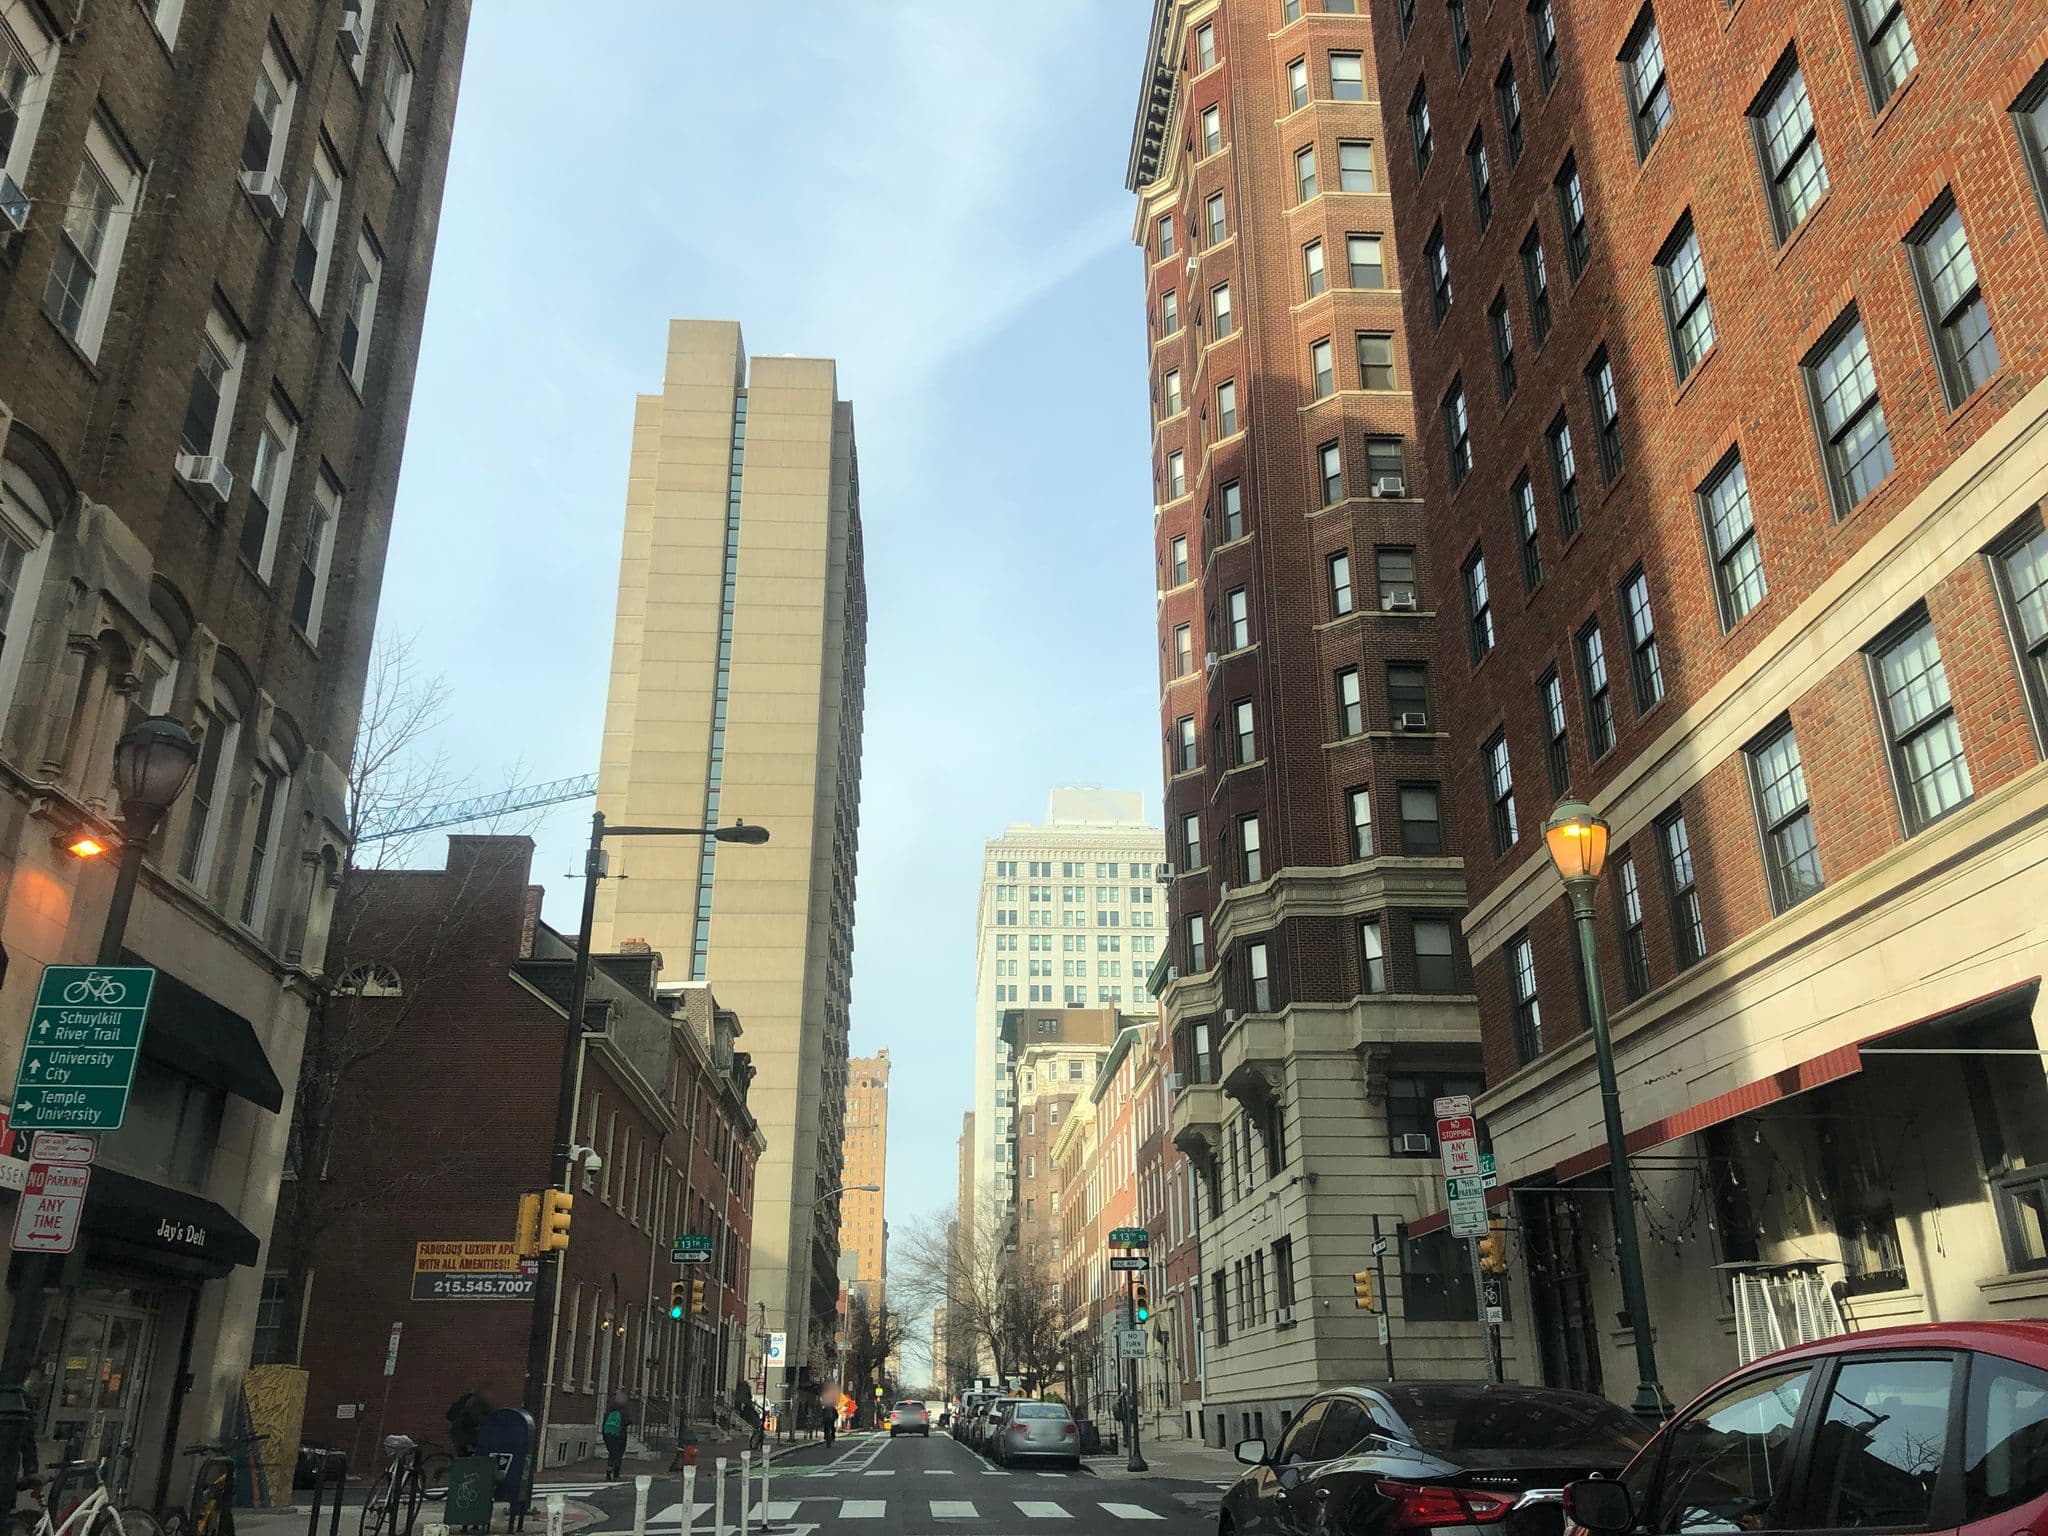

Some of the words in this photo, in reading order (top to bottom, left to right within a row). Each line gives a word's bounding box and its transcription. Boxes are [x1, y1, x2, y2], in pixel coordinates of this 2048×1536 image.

[58, 1011, 122, 1027] Schuylkill
[55, 1027, 89, 1040] River
[94, 1028, 120, 1040] Trail
[49, 1051, 114, 1068] University
[45, 1067, 71, 1083] City
[41, 1090, 86, 1107] Temple
[36, 1107, 101, 1125] University
[1450, 1119, 1460, 1129] NO
[1441, 1128, 1472, 1140] STOPPING
[1451, 1141, 1467, 1153] ANY
[1450, 1152, 1469, 1163] TIME
[27, 1170, 46, 1188] NO
[46, 1174, 85, 1188] PARKING
[1449, 1183, 1456, 1198] 2
[37, 1198, 65, 1212] ANY
[33, 1214, 63, 1229] TIME
[156, 1218, 184, 1242] Jay's
[185, 1224, 206, 1246] Deli
[420, 1243, 463, 1255] FABULOUS
[464, 1244, 497, 1255] LUXURY
[418, 1258, 440, 1270] WITH
[441, 1258, 457, 1270] ALL
[460, 1258, 510, 1270] AMENITIES!!
[433, 1281, 533, 1293] 215.545.7007
